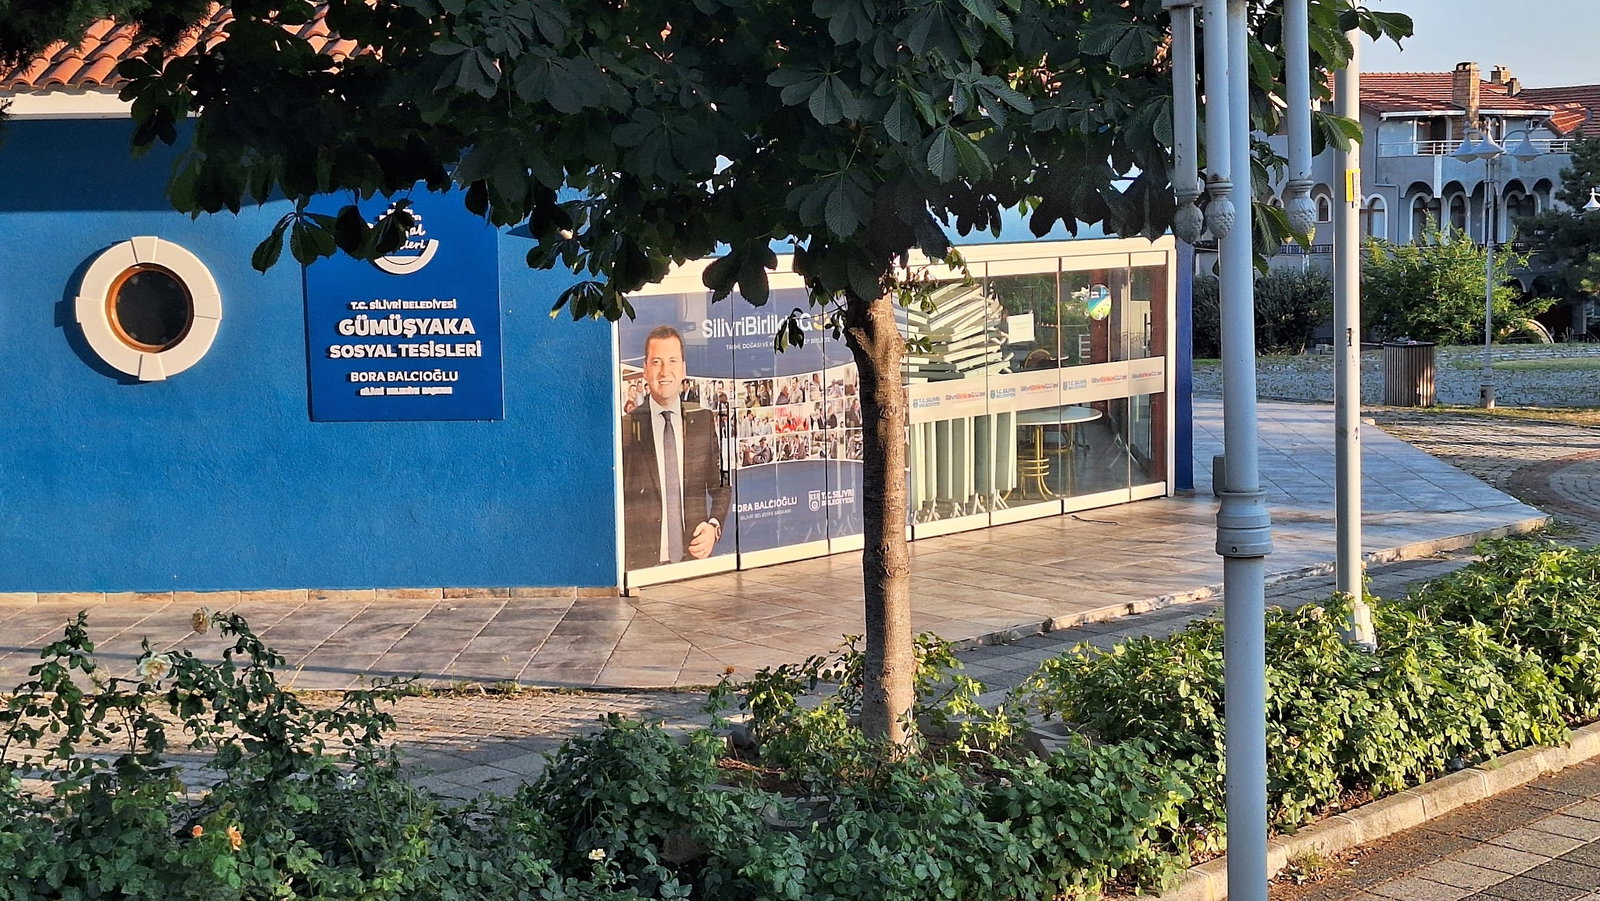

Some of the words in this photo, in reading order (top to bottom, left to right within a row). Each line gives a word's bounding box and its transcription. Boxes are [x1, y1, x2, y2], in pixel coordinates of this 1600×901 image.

[351, 301, 368, 310] T.C.
[369, 299, 401, 310] SİLİVRİ
[402, 298, 457, 309] BELEDİYESİ
[338, 314, 476, 338] GÜMÜŞYAKA
[329, 344, 397, 359] SOSYAL
[398, 340, 482, 357] TESİSLERİ
[350, 371, 386, 382] BORA
[387, 369, 459, 382] BALCIOĞLU
[754, 496, 797, 510] BALCIOĞLU
